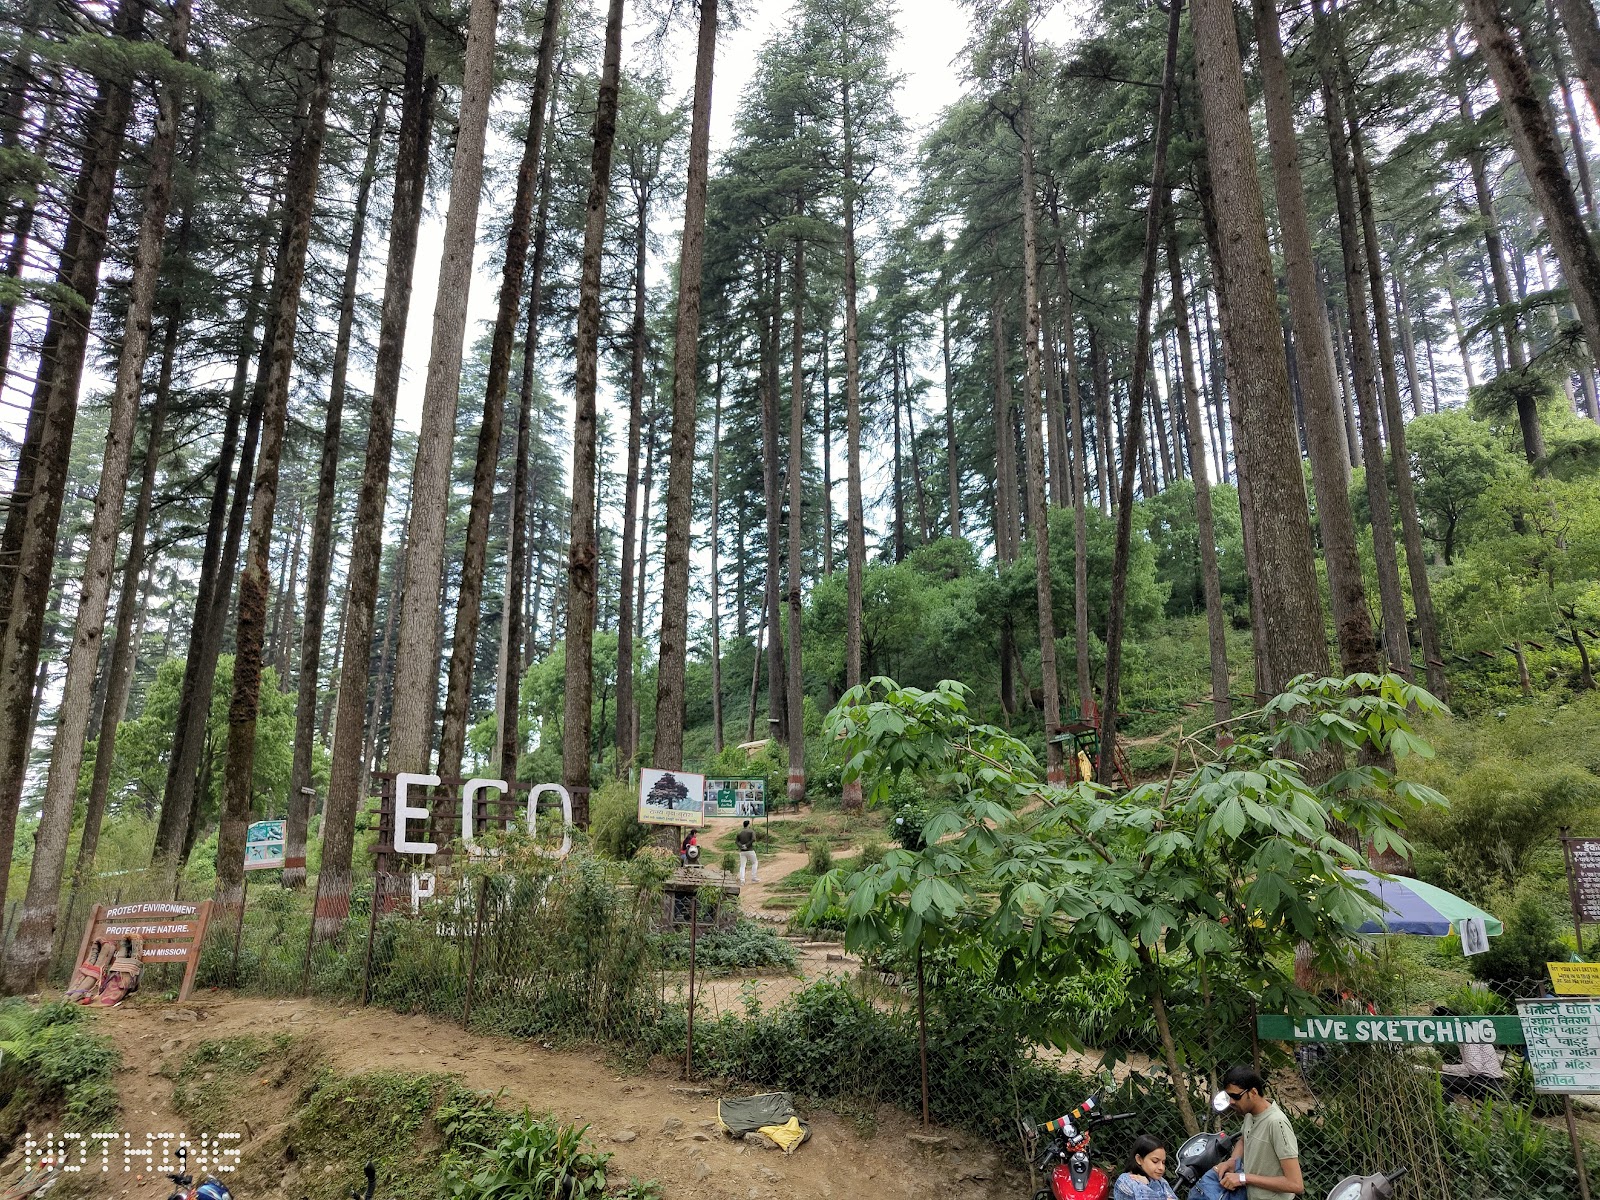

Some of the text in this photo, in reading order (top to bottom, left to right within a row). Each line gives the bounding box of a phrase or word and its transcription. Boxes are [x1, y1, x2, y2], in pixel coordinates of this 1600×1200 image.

[394, 772, 573, 860] ECO
[106, 904, 143, 918] PROTECT
[105, 924, 190, 935] PROTECT THE NATURE.
[156, 948, 187, 956] MISSION
[1293, 1018, 1349, 1040] LIVE
